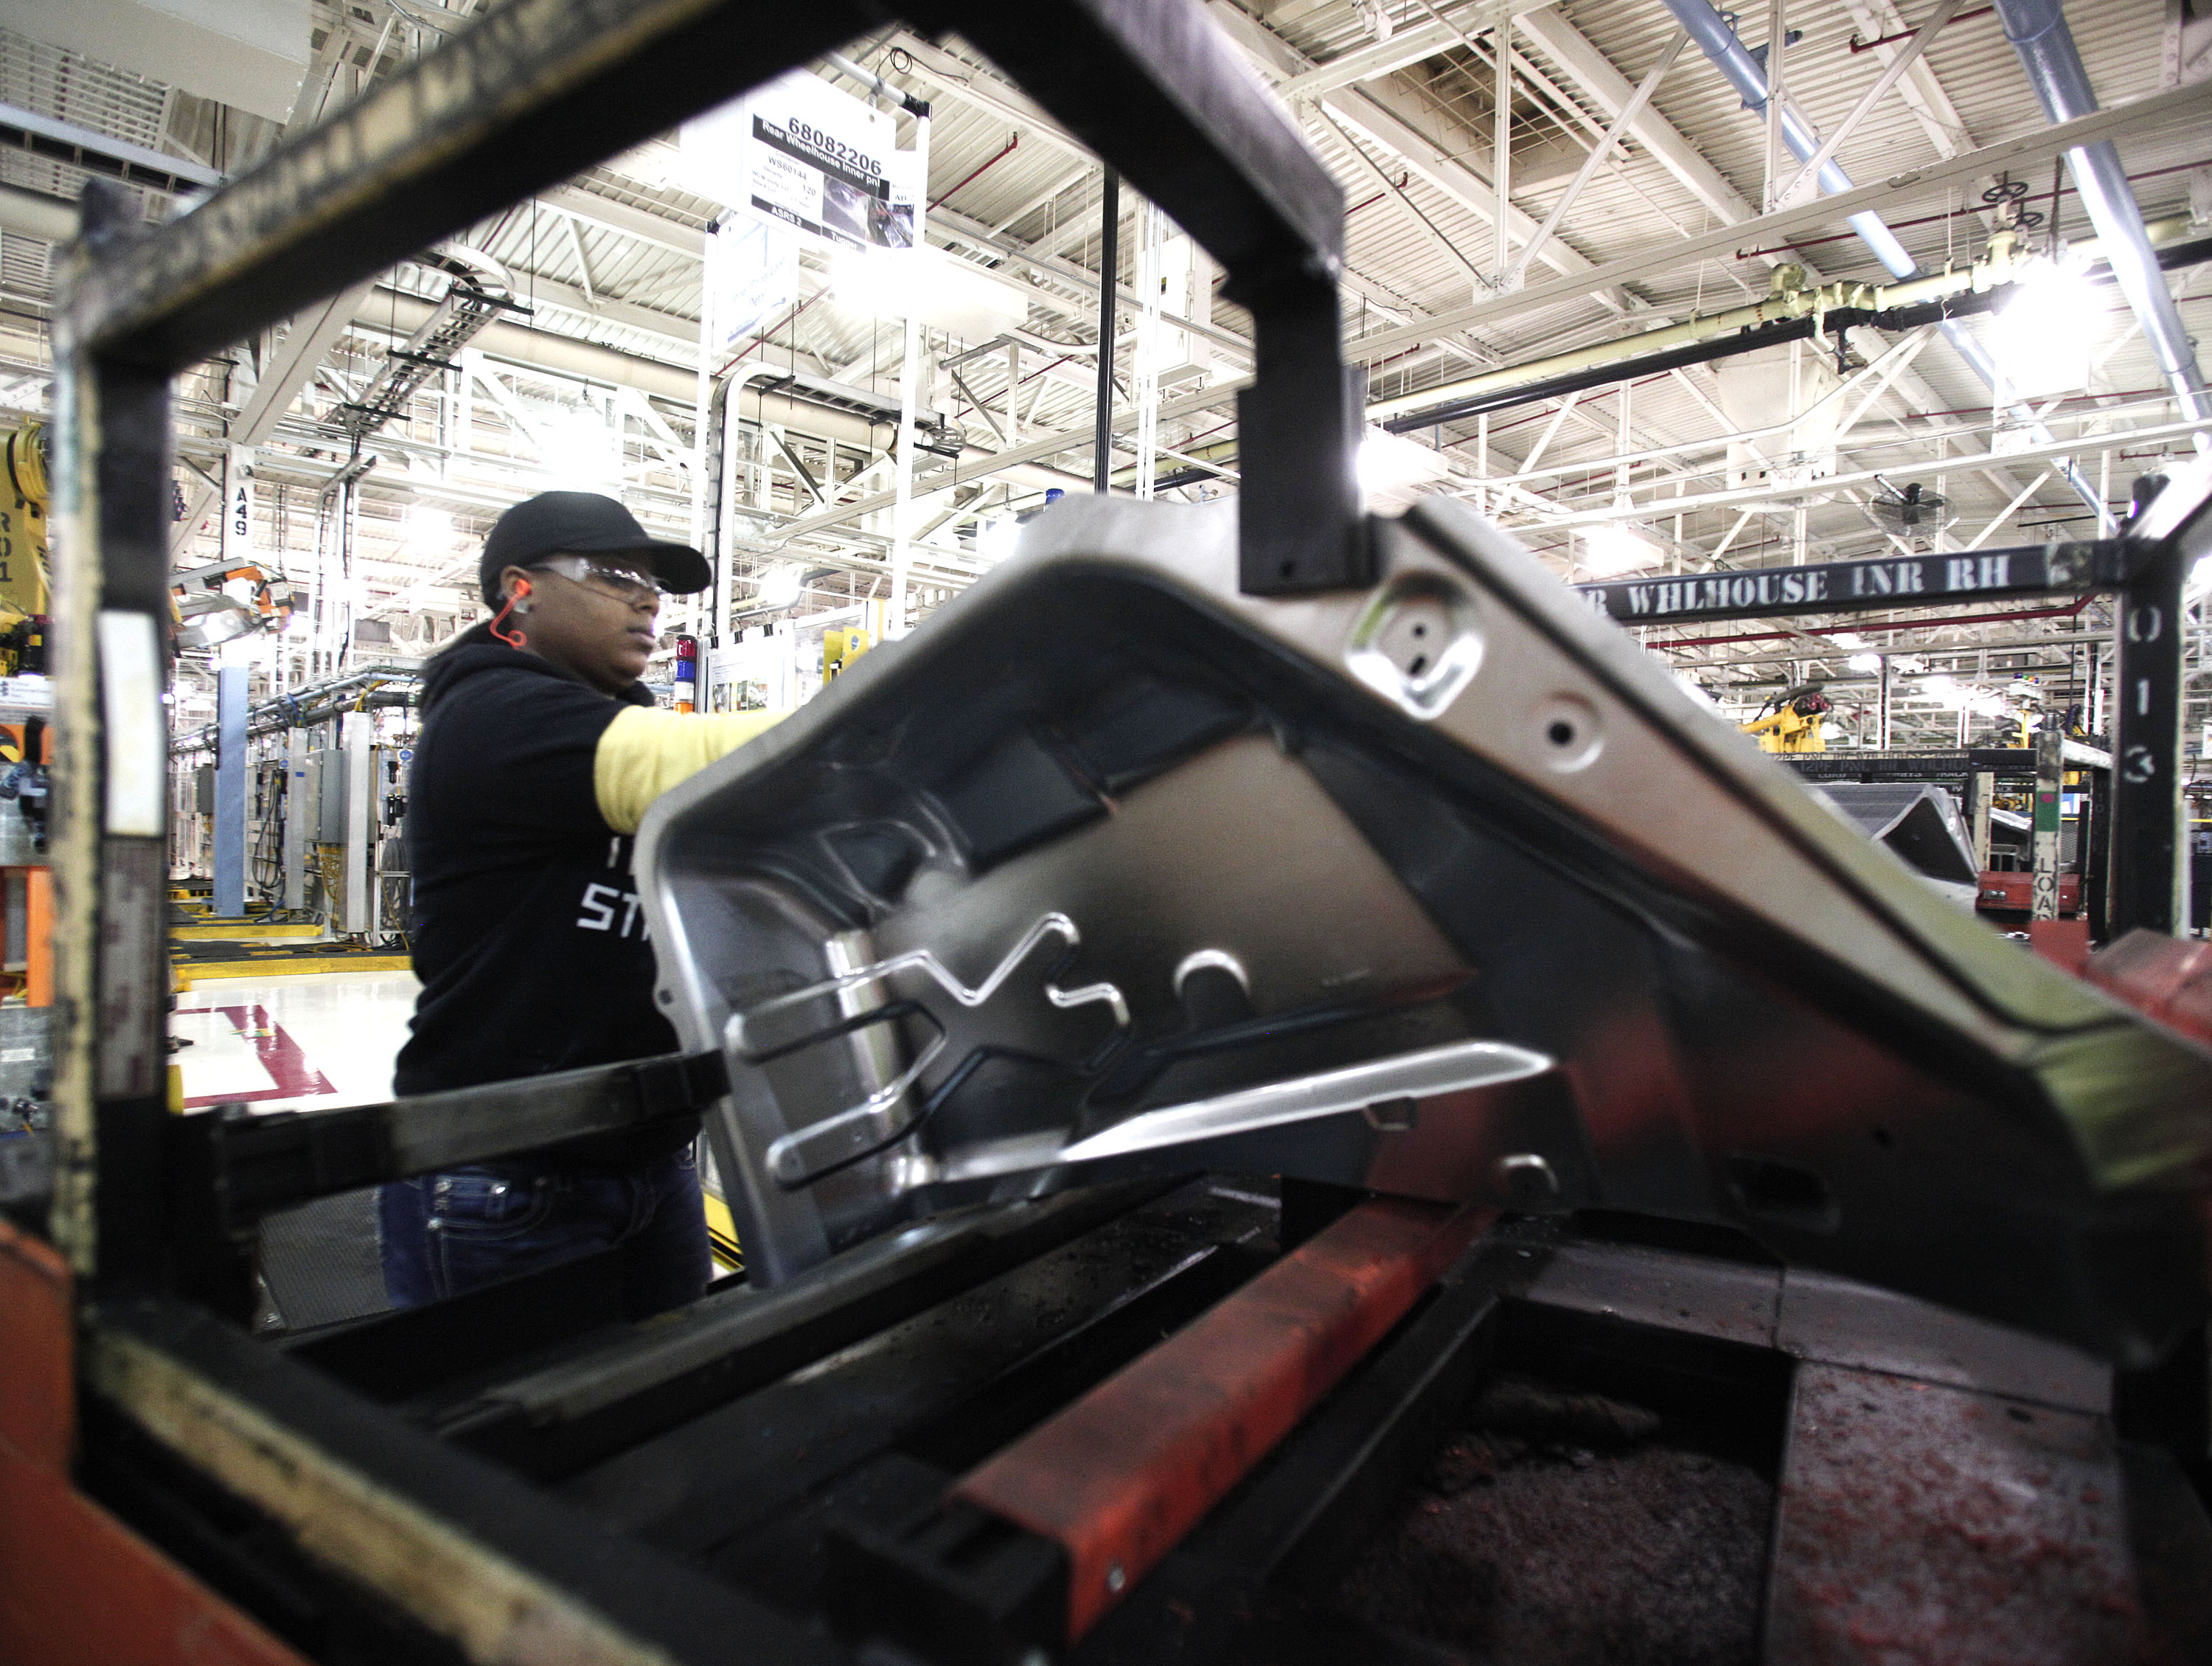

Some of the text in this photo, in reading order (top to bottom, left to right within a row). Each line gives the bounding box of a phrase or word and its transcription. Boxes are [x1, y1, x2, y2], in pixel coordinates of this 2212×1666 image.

[762, 119, 785, 139] Rear
[786, 132, 841, 169] Wheelhouse
[866, 175, 880, 188] pnl
[768, 155, 807, 181] WS60144
[788, 117, 882, 176] 68082206
[803, 184, 816, 196] 120
[771, 206, 795, 223] ASRS
[796, 218, 802, 227] 2
[235, 487, 248, 535] A49
[1627, 571, 1829, 615] WHLHOUSE
[1852, 561, 1924, 597] INR
[1945, 554, 2011, 591] RH
